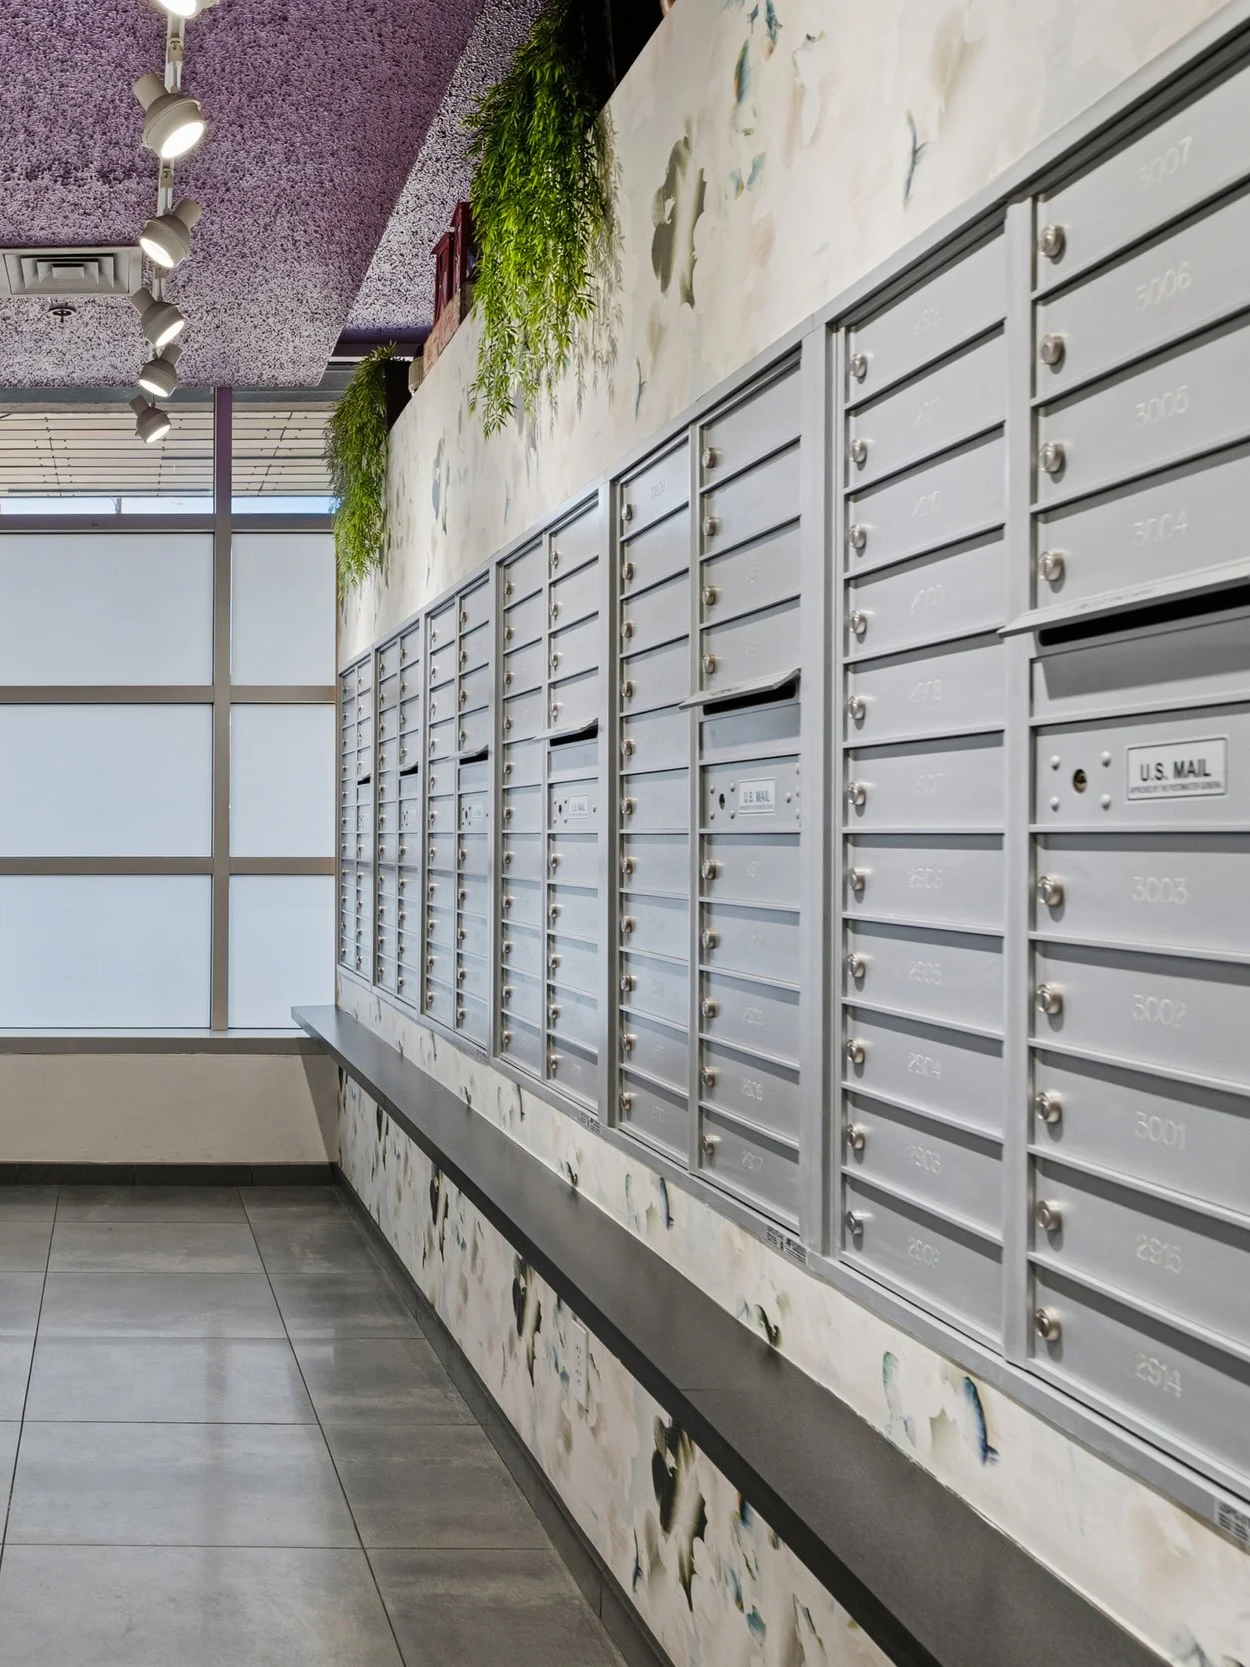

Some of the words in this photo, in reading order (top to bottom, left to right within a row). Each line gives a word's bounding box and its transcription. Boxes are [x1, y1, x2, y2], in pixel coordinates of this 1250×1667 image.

[1137, 135, 1192, 191] 3007
[1135, 260, 1192, 313] 3006
[1132, 384, 1189, 429] 3005
[1132, 508, 1188, 547] 3004
[1140, 762, 1169, 782] U.S.
[1173, 758, 1211, 779] MAIL
[755, 790, 770, 802] MAIL
[1131, 876, 1189, 905] 3003
[1132, 993, 1187, 1028] 3002
[908, 1052, 942, 1081] 2904
[1134, 1110, 1186, 1150] 3001
